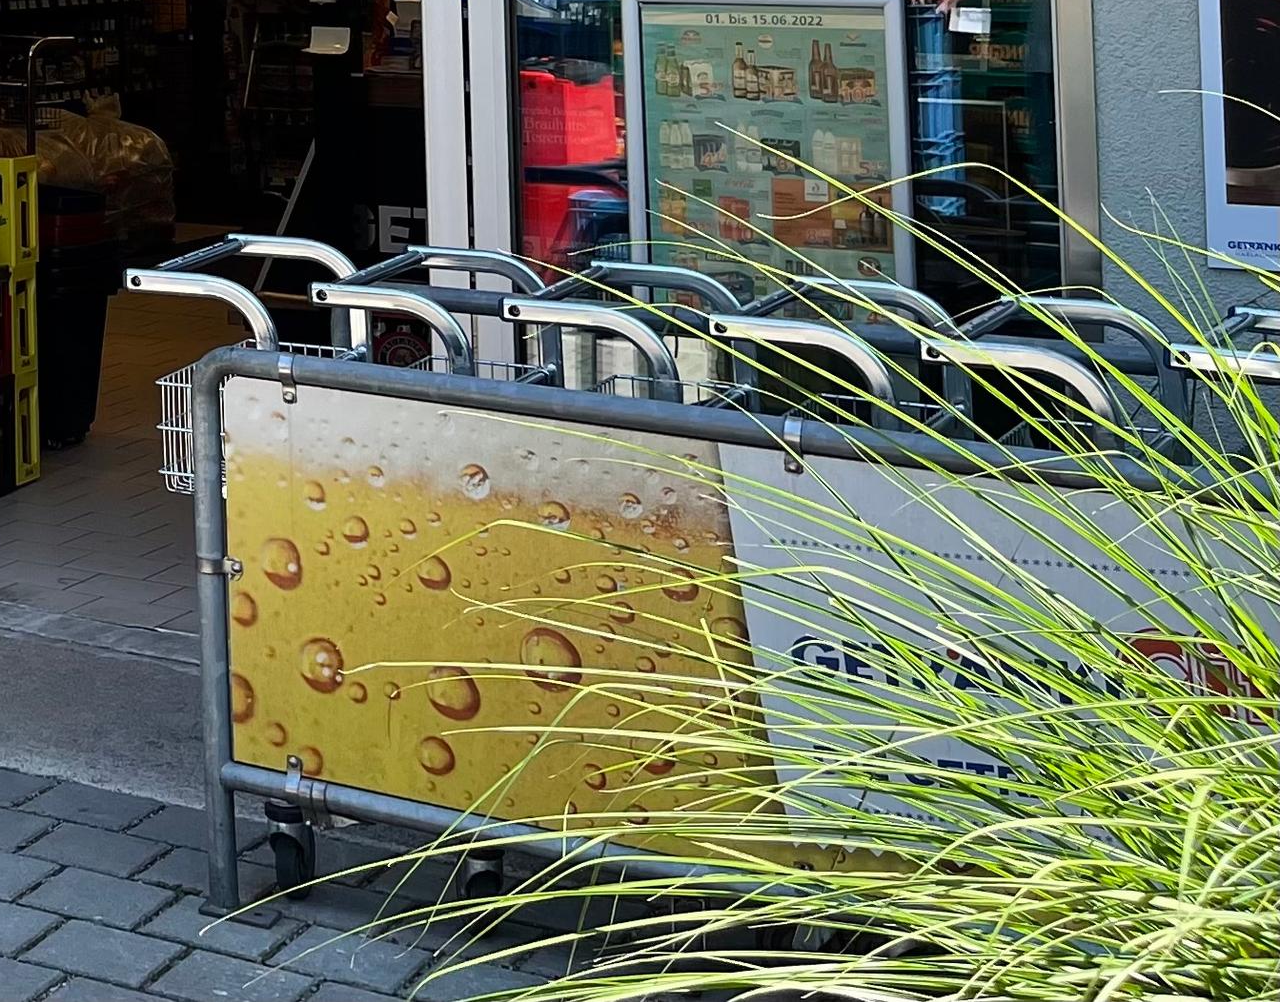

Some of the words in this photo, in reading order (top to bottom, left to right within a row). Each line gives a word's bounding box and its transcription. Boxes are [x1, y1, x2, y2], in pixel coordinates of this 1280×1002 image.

[705, 13, 725, 25] 01.
[729, 13, 747, 25] bis
[752, 14, 824, 27] 15.06.2022
